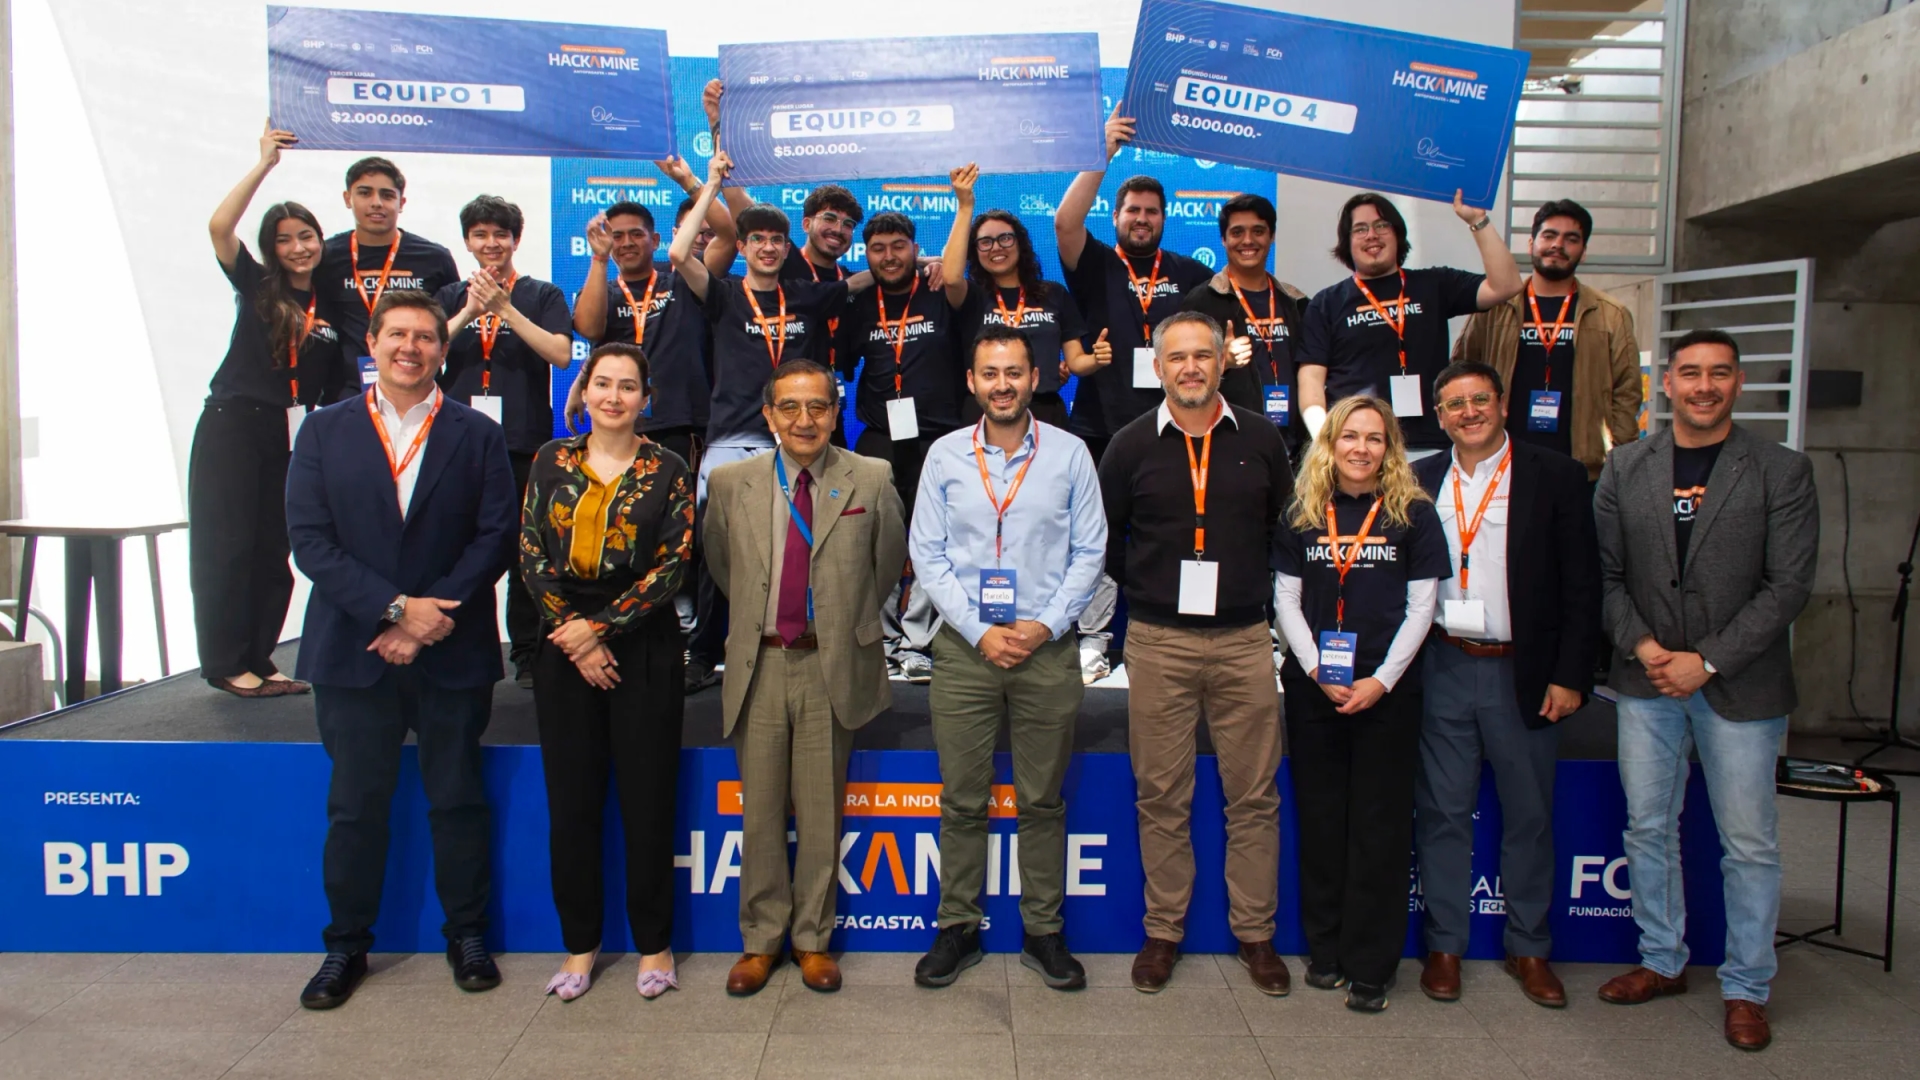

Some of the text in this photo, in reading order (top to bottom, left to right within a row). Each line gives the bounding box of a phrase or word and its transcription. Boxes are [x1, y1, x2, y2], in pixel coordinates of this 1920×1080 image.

[1165, 32, 1186, 44] BHP
[1180, 68, 1228, 81] SEGUNDO LUGAR
[353, 82, 493, 104] EQUIPO 1
[1184, 82, 1318, 122] EQUIPO 4
[331, 111, 433, 126] $2.000.000.-
[788, 109, 921, 132] EQUIPO 2
[1171, 112, 1261, 139] $3.000.000.-
[774, 142, 867, 158] $5.000.000.-
[867, 195, 958, 212] HACKAMIN
[44, 792, 140, 805] PRESENTA:
[874, 794, 898, 807] LA
[43, 841, 190, 896] BHP
[1570, 855, 1632, 899] FC
